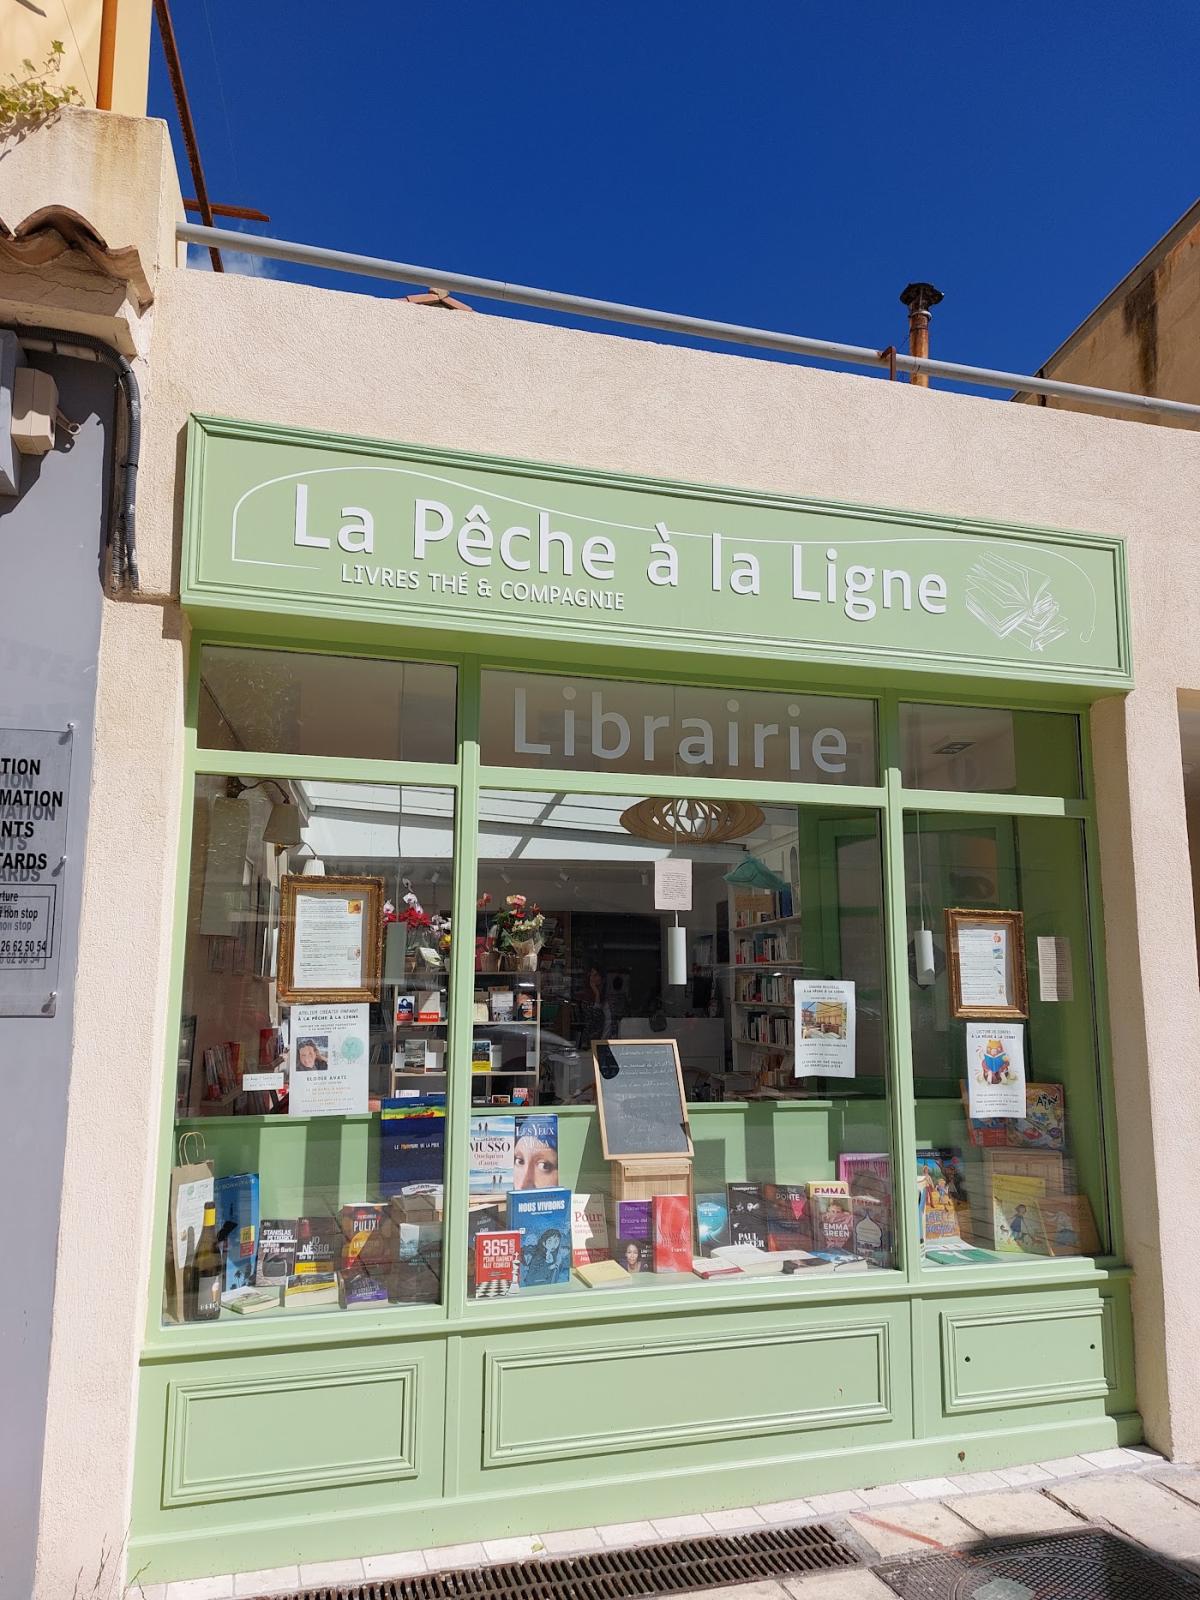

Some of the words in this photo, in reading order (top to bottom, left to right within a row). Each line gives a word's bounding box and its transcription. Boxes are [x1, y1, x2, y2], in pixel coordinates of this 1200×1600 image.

[293, 484, 374, 554] La
[413, 498, 616, 580] Pêche
[647, 521, 679, 587] à
[711, 532, 761, 596] la
[791, 543, 948, 622] Ligne
[341, 563, 419, 590] LIVRES
[427, 571, 469, 596] THÉ
[477, 578, 492, 597] &
[500, 580, 625, 612] COMPAGNIE
[514, 686, 848, 774] Librairie
[0, 758, 41, 776] TION
[0, 788, 63, 807] MATION
[2, 820, 34, 838] NTS
[0, 852, 47, 870] ARDS
[21, 908, 38, 922] stop
[1, 941, 11, 952] 26
[13, 941, 23, 952] 62
[25, 941, 35, 952] 50
[36, 941, 47, 952] 54
[470, 1141, 511, 1153] MUSSO
[814, 1187, 847, 1196] EMMA
[518, 1201, 537, 1213] NOUS
[823, 1222, 849, 1231] EMMA
[738, 1232, 758, 1241] PAUL
[482, 1239, 509, 1256] 365
